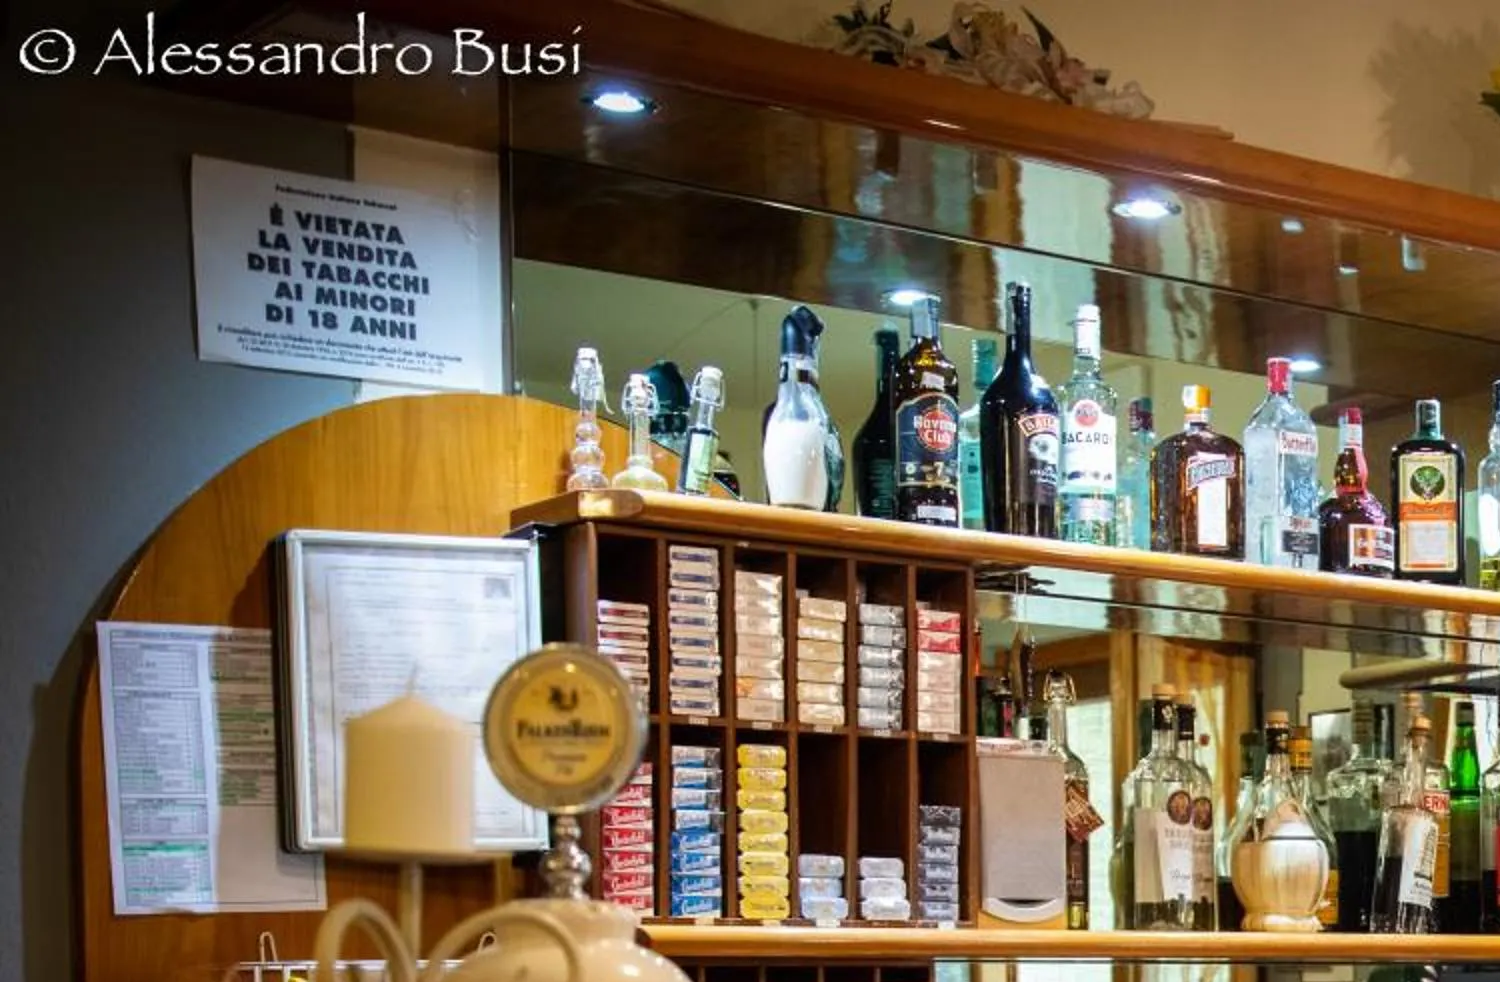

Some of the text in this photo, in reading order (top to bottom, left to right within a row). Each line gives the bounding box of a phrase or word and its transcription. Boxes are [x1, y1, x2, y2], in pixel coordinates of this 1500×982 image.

[294, 210, 405, 245] VIETATA
[258, 230, 417, 270] LA VENDITA
[247, 252, 430, 295] DEI TABACCHI
[275, 282, 416, 317] AI MINORI
[265, 304, 417, 341] DI 18 ANNI
